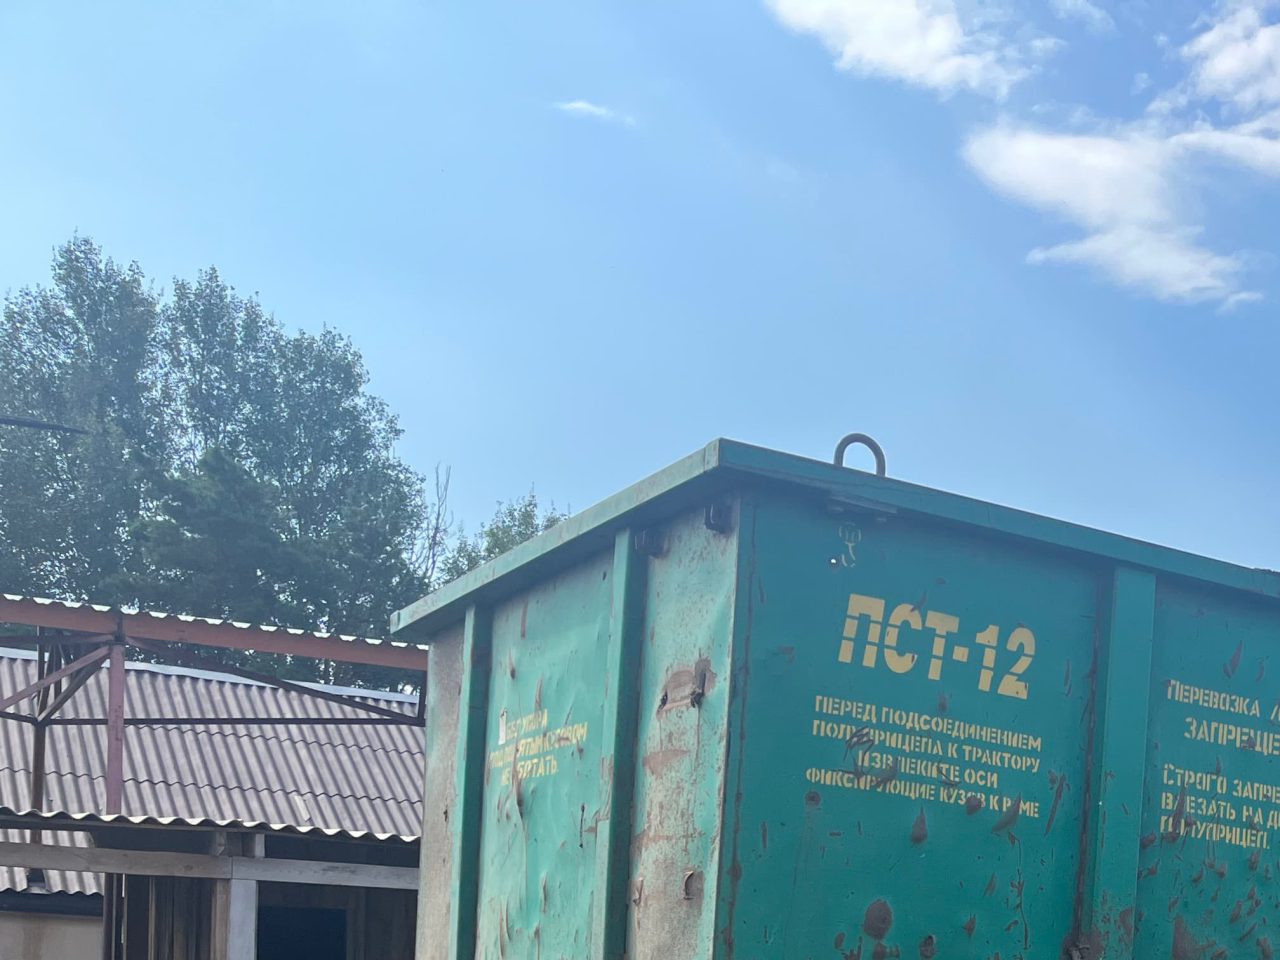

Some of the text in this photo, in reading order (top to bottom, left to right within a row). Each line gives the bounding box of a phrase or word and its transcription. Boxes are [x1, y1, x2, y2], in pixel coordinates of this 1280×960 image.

[838, 593, 1036, 700] ПСТ-12
[1167, 679, 1260, 718] ПЕРЕВОЗКА
[815, 695, 1042, 752] ПЕРЕД ПОДСОЕДИНЕНИЕМ
[947, 742, 959, 758] К
[962, 745, 1040, 773] ТРАКТОРУ
[964, 769, 998, 789] ОСИ
[1163, 763, 1227, 794] СТРОГО
[989, 795, 999, 811] К
[1002, 797, 1039, 818] РМЕ
[1242, 805, 1264, 825] НА
